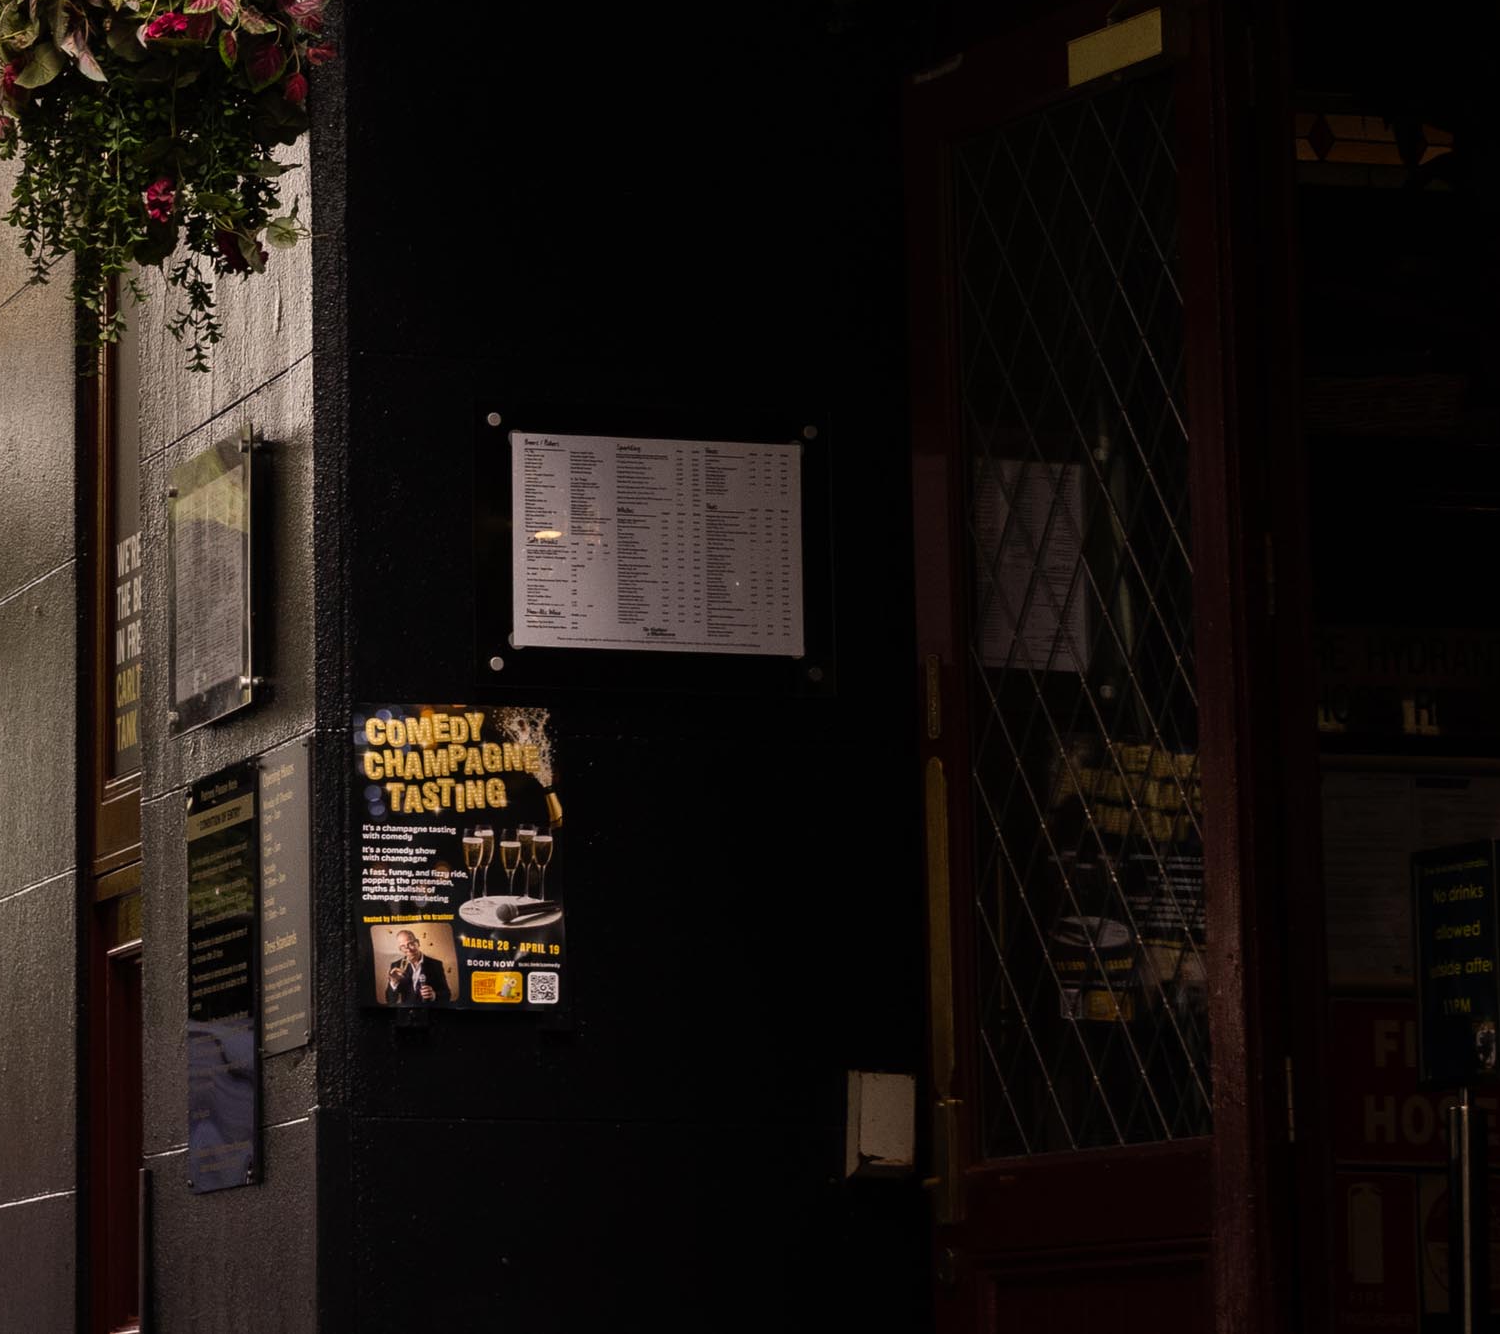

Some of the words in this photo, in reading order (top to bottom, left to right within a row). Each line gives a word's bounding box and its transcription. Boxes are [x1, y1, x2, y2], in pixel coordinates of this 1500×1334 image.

[365, 712, 485, 748] COMEDY
[363, 742, 541, 781] CHAMPAGNE
[386, 778, 508, 814] TASTING
[382, 824, 428, 834] champagne
[428, 825, 456, 835] tasting
[381, 833, 413, 841] comedy
[382, 846, 414, 856] comedy
[414, 847, 437, 855] show
[362, 854, 380, 862] with
[381, 855, 428, 863] champagne
[431, 869, 449, 879] fizzy
[362, 878, 396, 886] popping
[396, 877, 410, 885] the
[362, 886, 388, 894] myths
[427, 886, 436, 894] of
[1448, 884, 1484, 902] drinks
[362, 894, 409, 902] champagne
[410, 895, 449, 903] marketing
[462, 935, 494, 950] MARCH
[519, 942, 547, 954] APRIL
[549, 944, 561, 955] 19
[466, 959, 490, 968] BOOK
[493, 960, 515, 968] NOW
